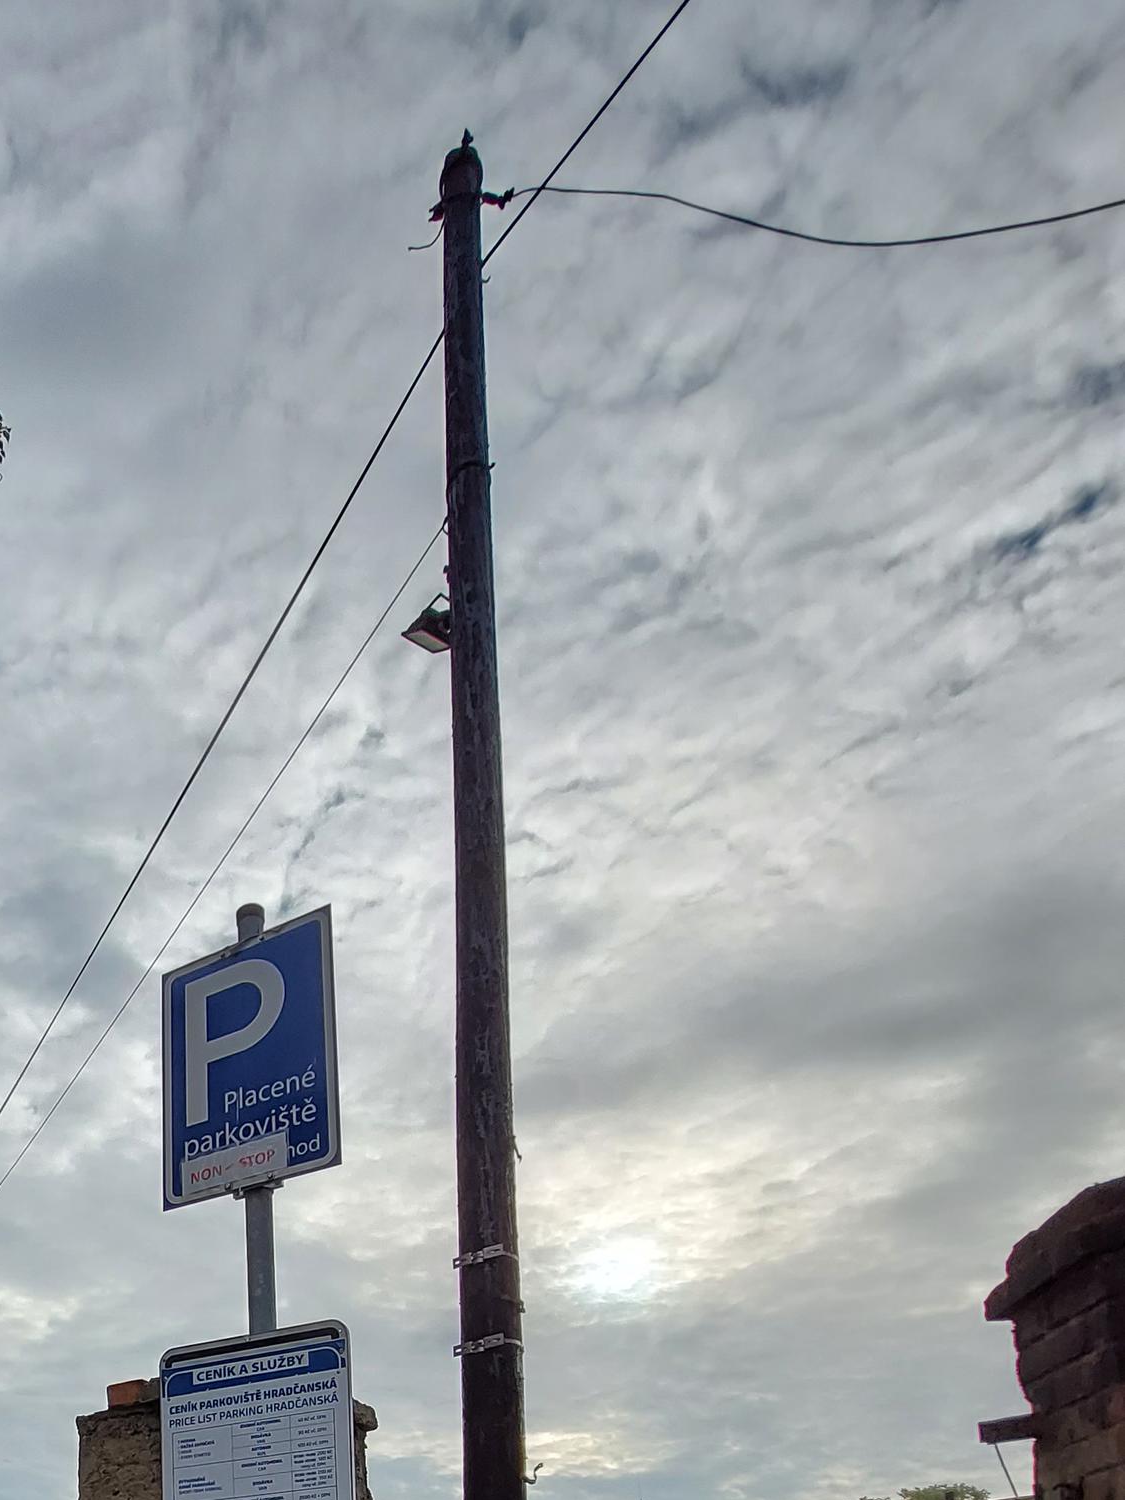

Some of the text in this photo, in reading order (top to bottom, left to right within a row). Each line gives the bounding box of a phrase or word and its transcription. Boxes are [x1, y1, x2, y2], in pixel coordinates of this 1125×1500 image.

[185, 959, 285, 1127] P
[224, 1064, 316, 1113] Placené
[184, 1096, 317, 1162] parkoviště
[196, 1353, 305, 1382] CENÍK A SLUŽBY
[169, 1377, 337, 1415] CENÍK PARKOVIŠTĚ HRADČANSKÁ
[169, 1391, 339, 1428] PRICE LIST PARKING HRADČANSKÁ
